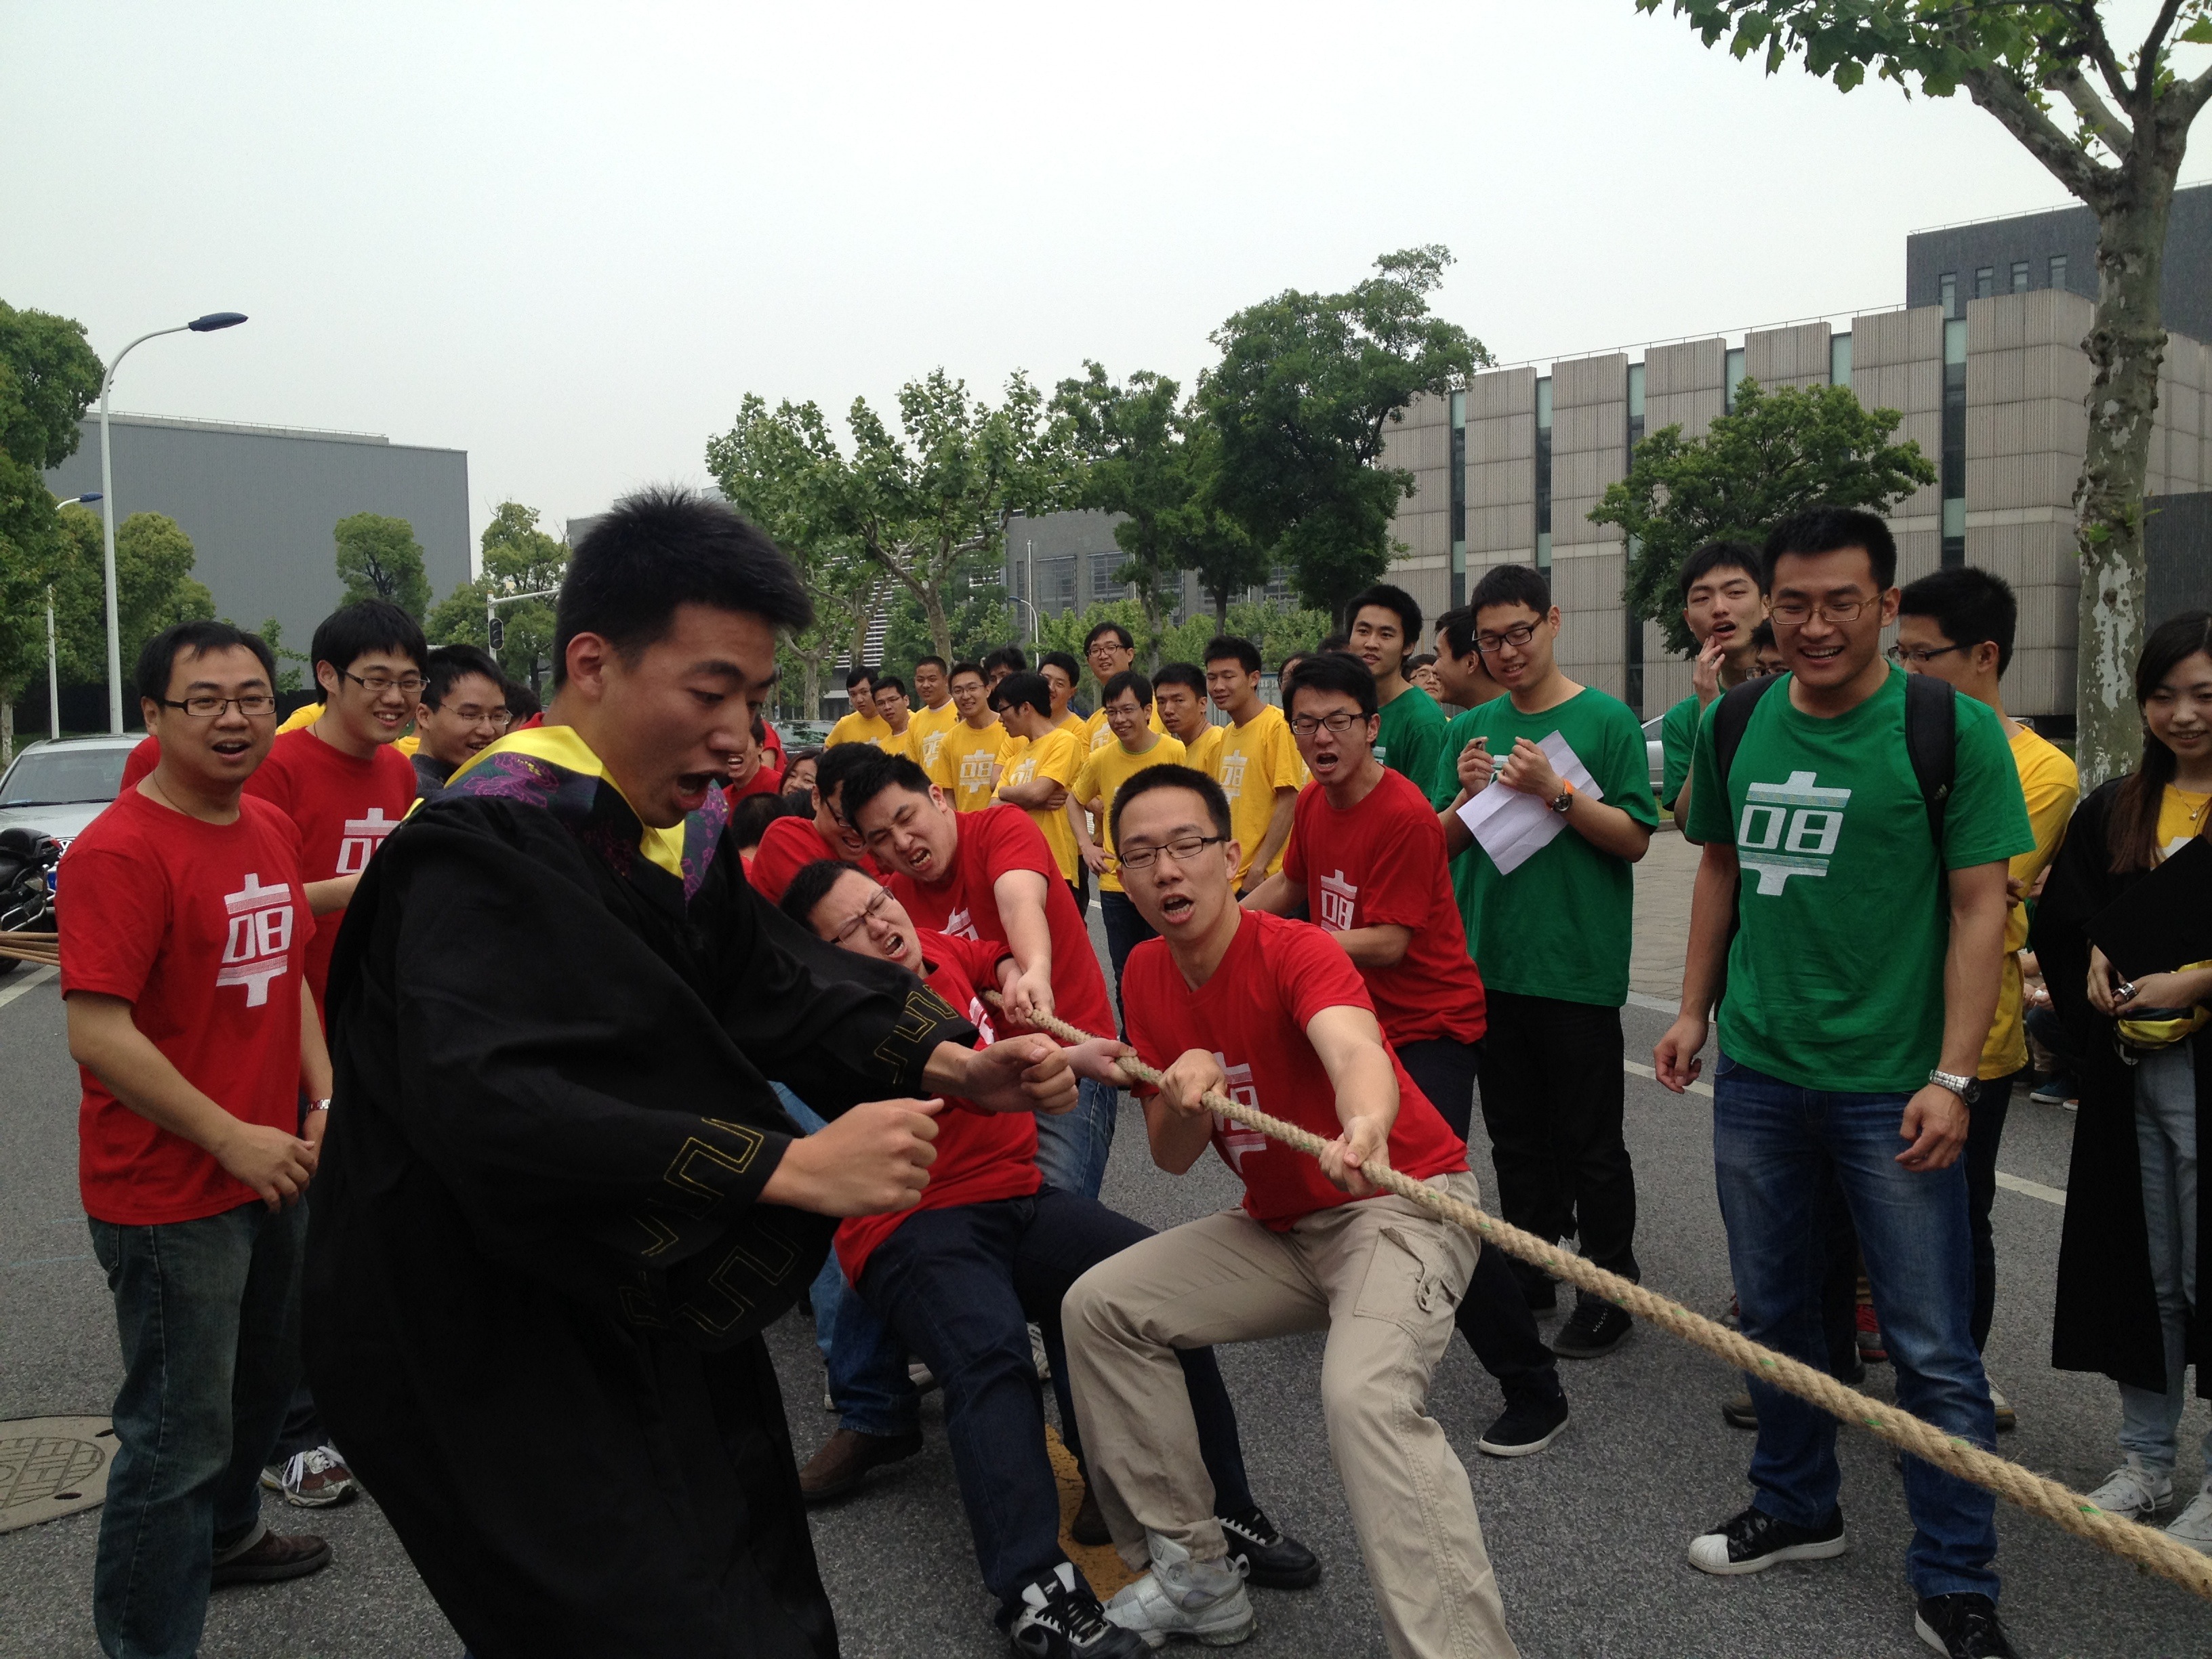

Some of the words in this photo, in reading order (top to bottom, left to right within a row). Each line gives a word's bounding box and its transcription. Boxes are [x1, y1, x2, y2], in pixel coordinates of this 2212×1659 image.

[960, 762, 993, 779] 08
[1219, 766, 1244, 786] 08
[1738, 804, 1843, 855] 08
[335, 838, 385, 874] 0
[1321, 890, 1355, 930] 08
[222, 905, 293, 963] 08
